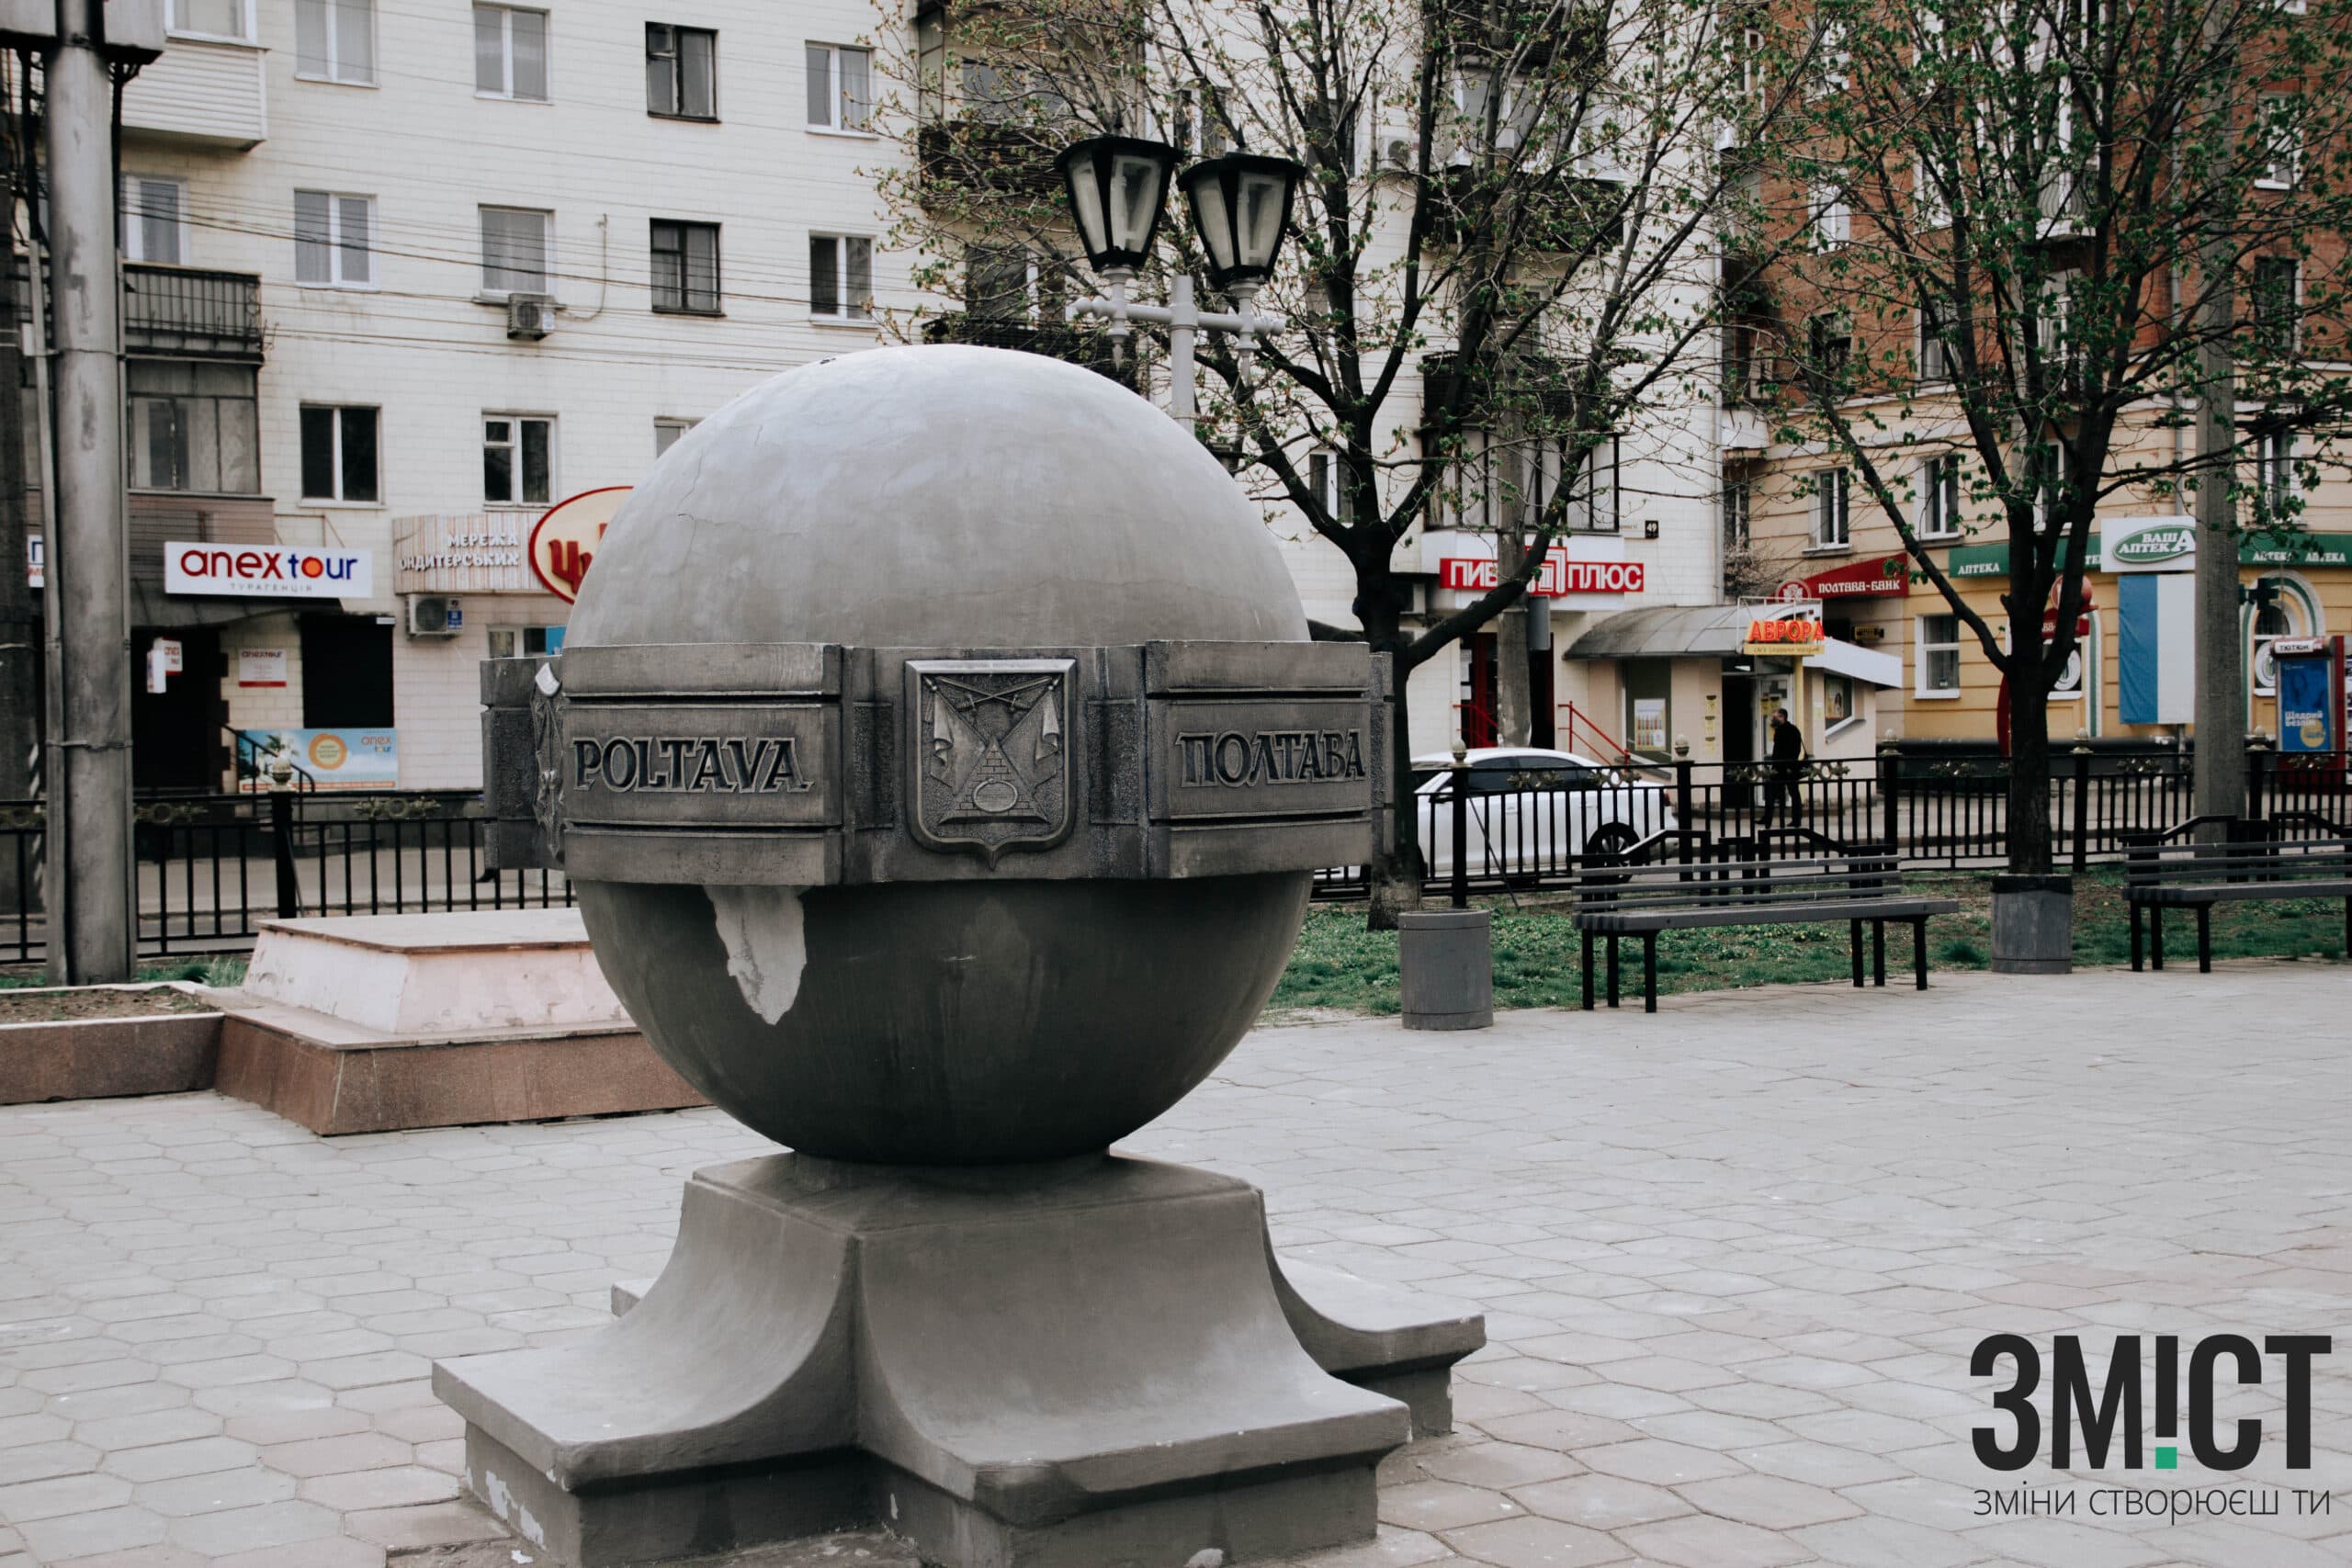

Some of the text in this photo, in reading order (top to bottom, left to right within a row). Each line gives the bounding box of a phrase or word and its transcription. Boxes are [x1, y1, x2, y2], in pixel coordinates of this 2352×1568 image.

[447, 532, 519, 548] МЕРЕЖА
[1645, 522, 1657, 533] 49
[180, 549, 358, 581] anex tour
[1450, 560, 1643, 591] ПИВ ПЛЮС
[1958, 562, 2000, 575] АПТЕКА
[1748, 620, 1826, 643] АВРОРА
[571, 736, 814, 793] POLTAVA
[1175, 728, 1366, 788] ПОЛТАВА
